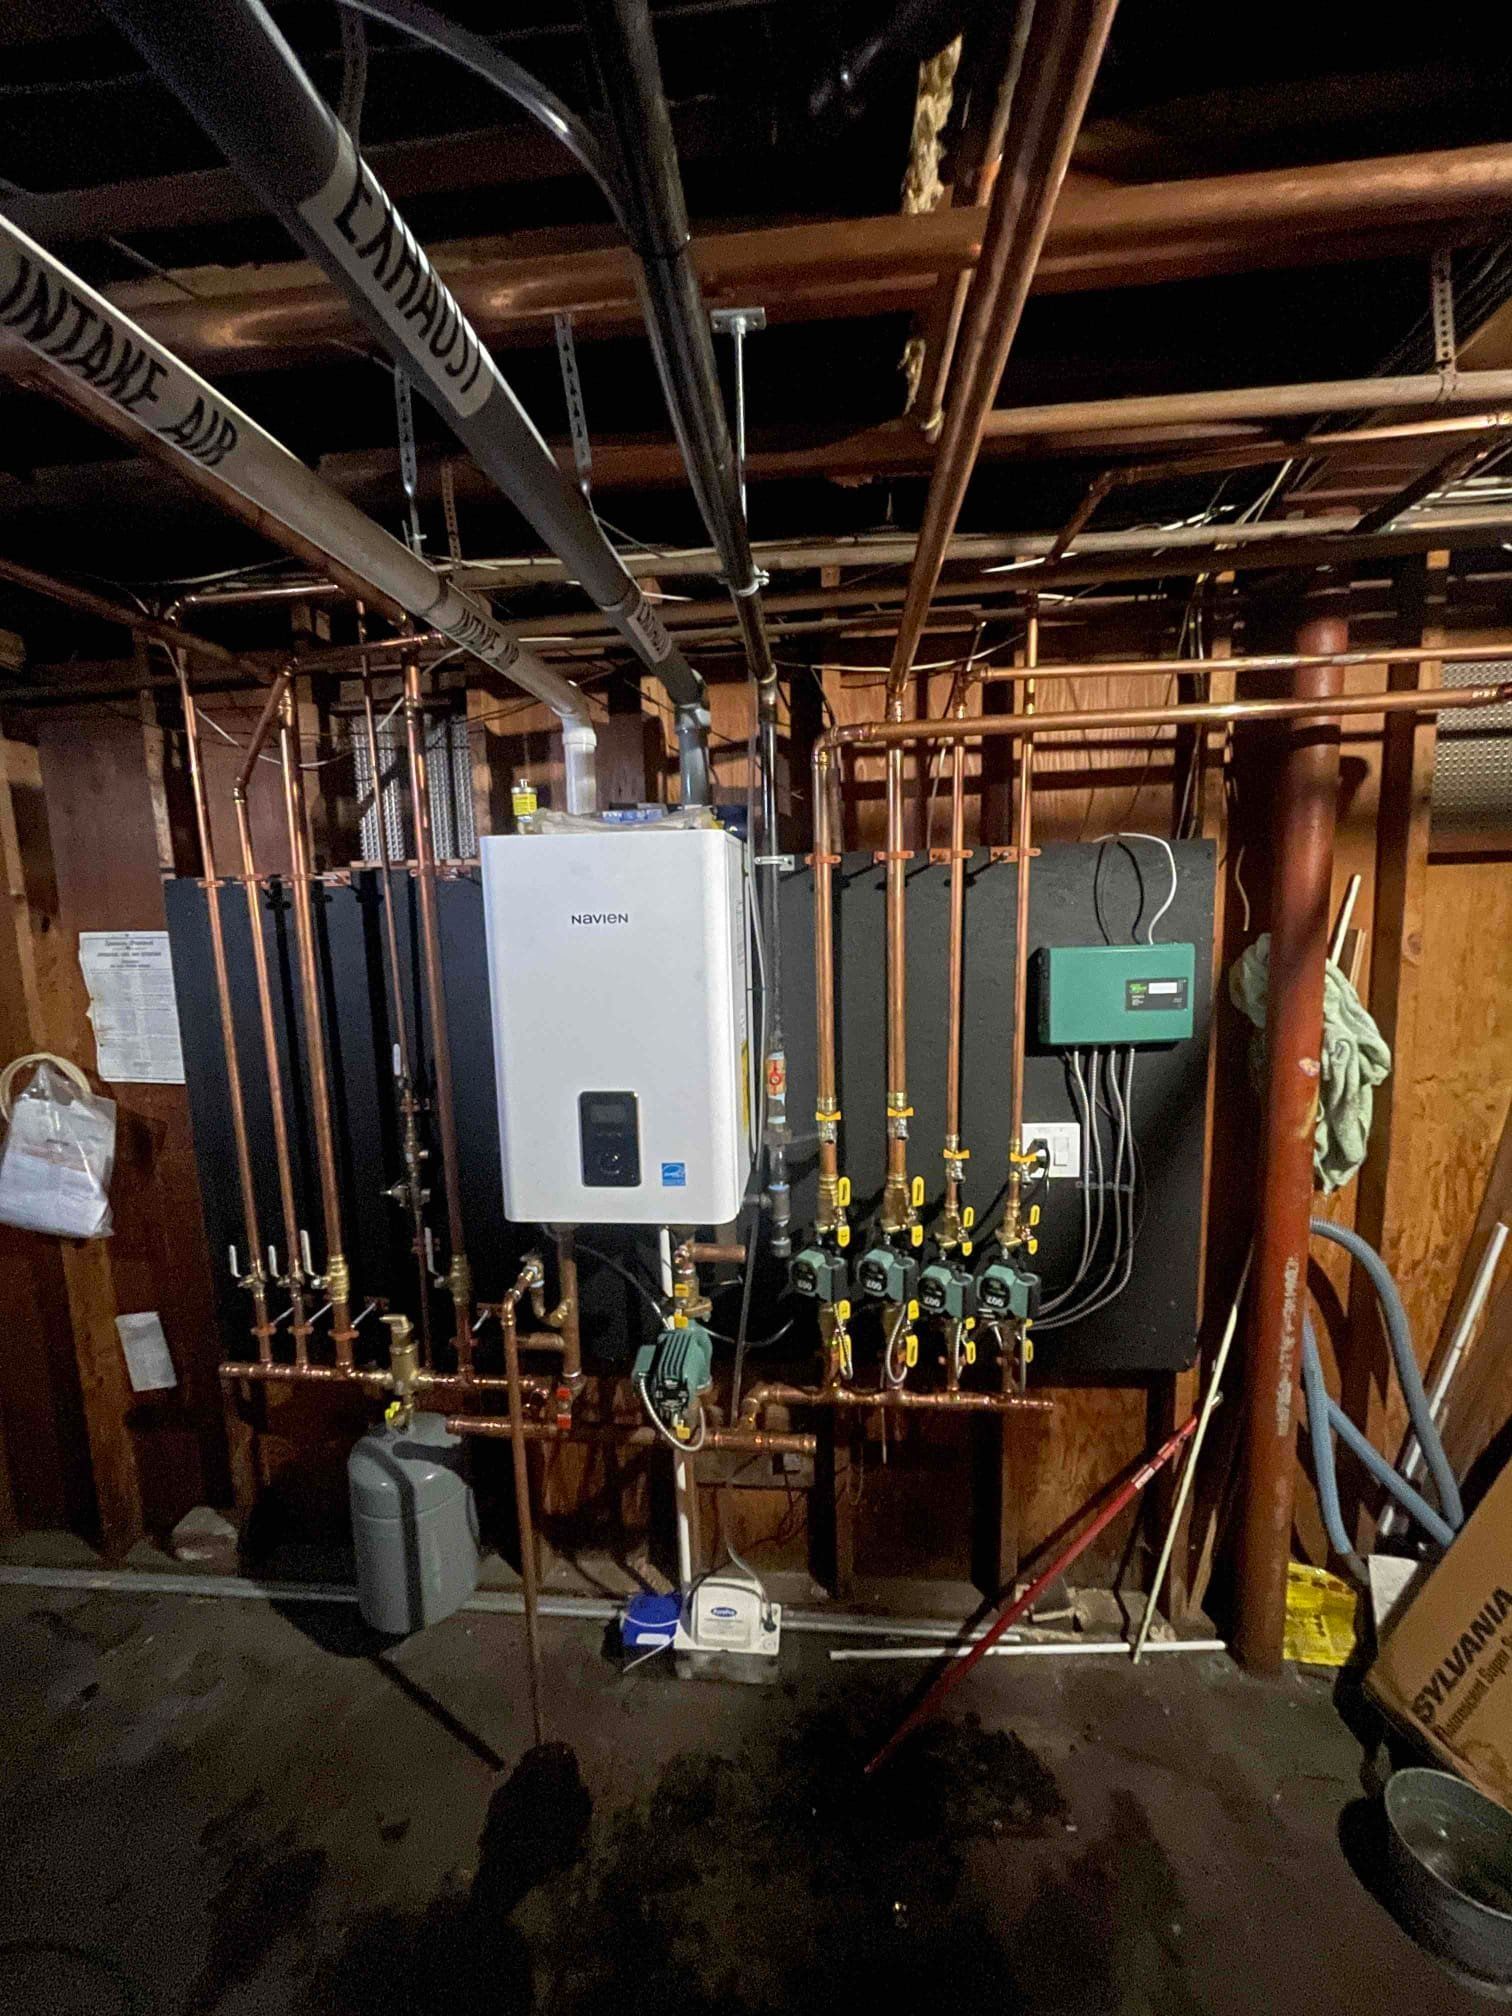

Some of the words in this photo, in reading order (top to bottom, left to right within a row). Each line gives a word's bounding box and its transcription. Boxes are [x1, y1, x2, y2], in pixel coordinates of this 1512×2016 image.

[0, 251, 168, 414] INTAKE
[157, 396, 237, 467] AIR
[334, 152, 481, 394] EXHAUST
[1411, 1586, 1512, 1725] SYLVANIA
